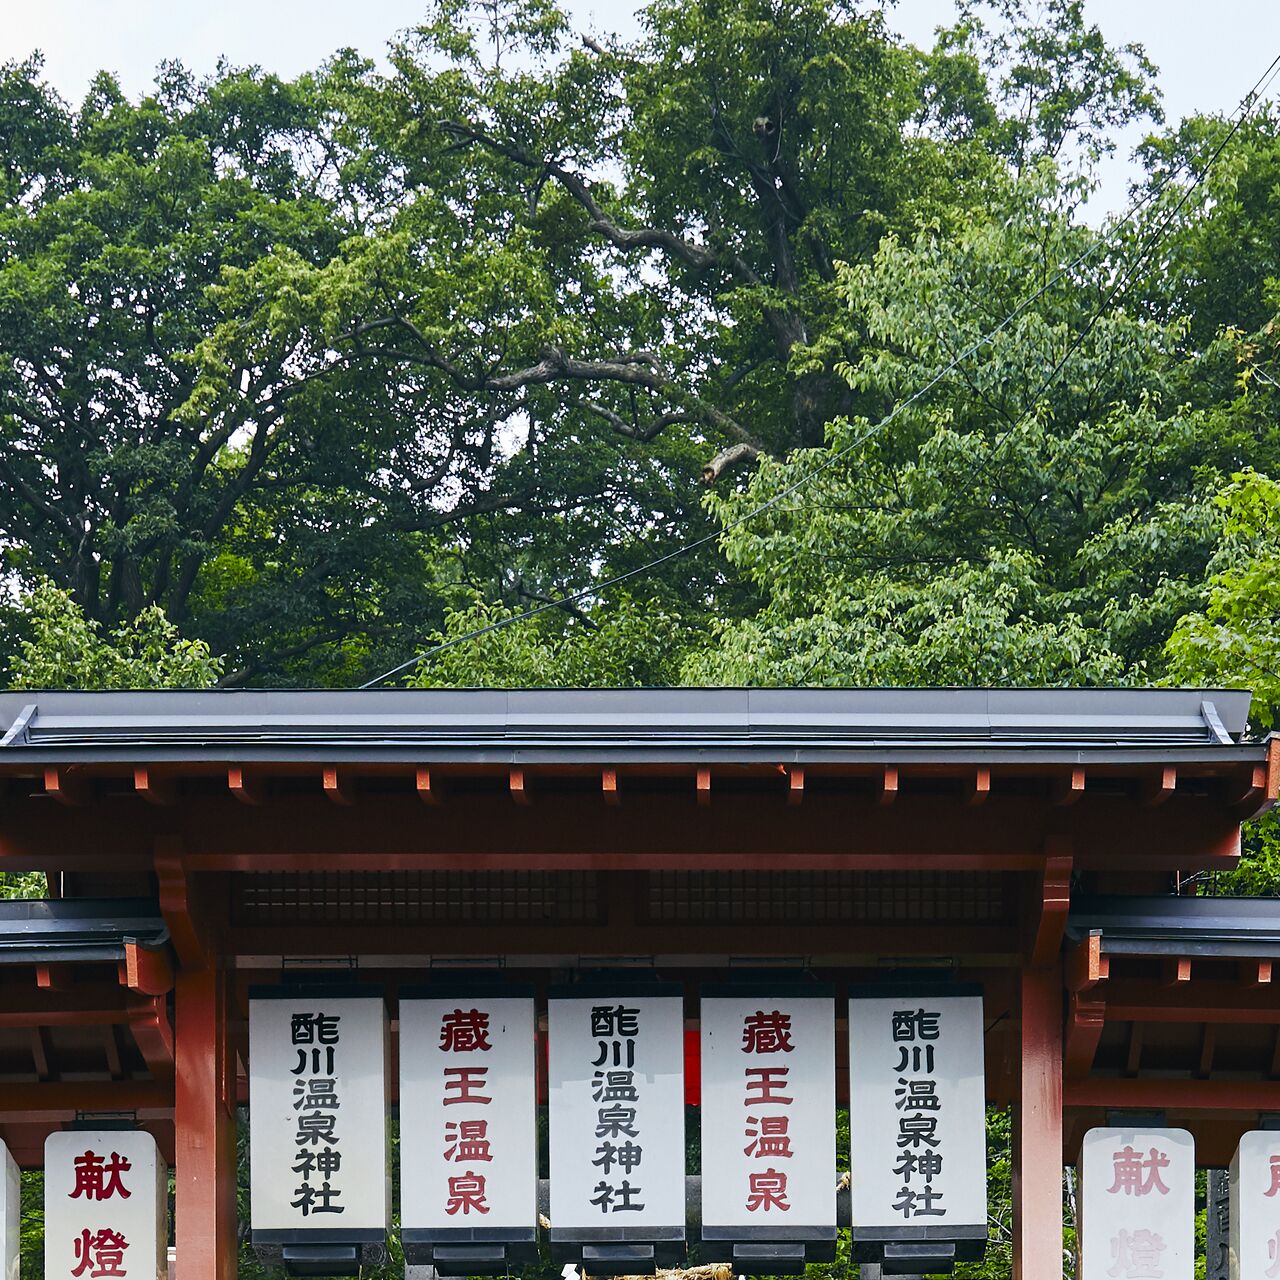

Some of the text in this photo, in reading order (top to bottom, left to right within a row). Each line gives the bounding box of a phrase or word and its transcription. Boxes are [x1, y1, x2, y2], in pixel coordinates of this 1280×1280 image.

[290, 1012, 345, 1216] 酢川温泉神社
[438, 1008, 494, 1215] 蔵王温泉
[590, 1004, 646, 1214] 酢川温泉神社
[741, 1010, 796, 1213] 蔵王温泉
[892, 1008, 948, 1218] 酢川温泉神社
[67, 1150, 133, 1278] 献燈
[1106, 1146, 1171, 1280] 献燈
